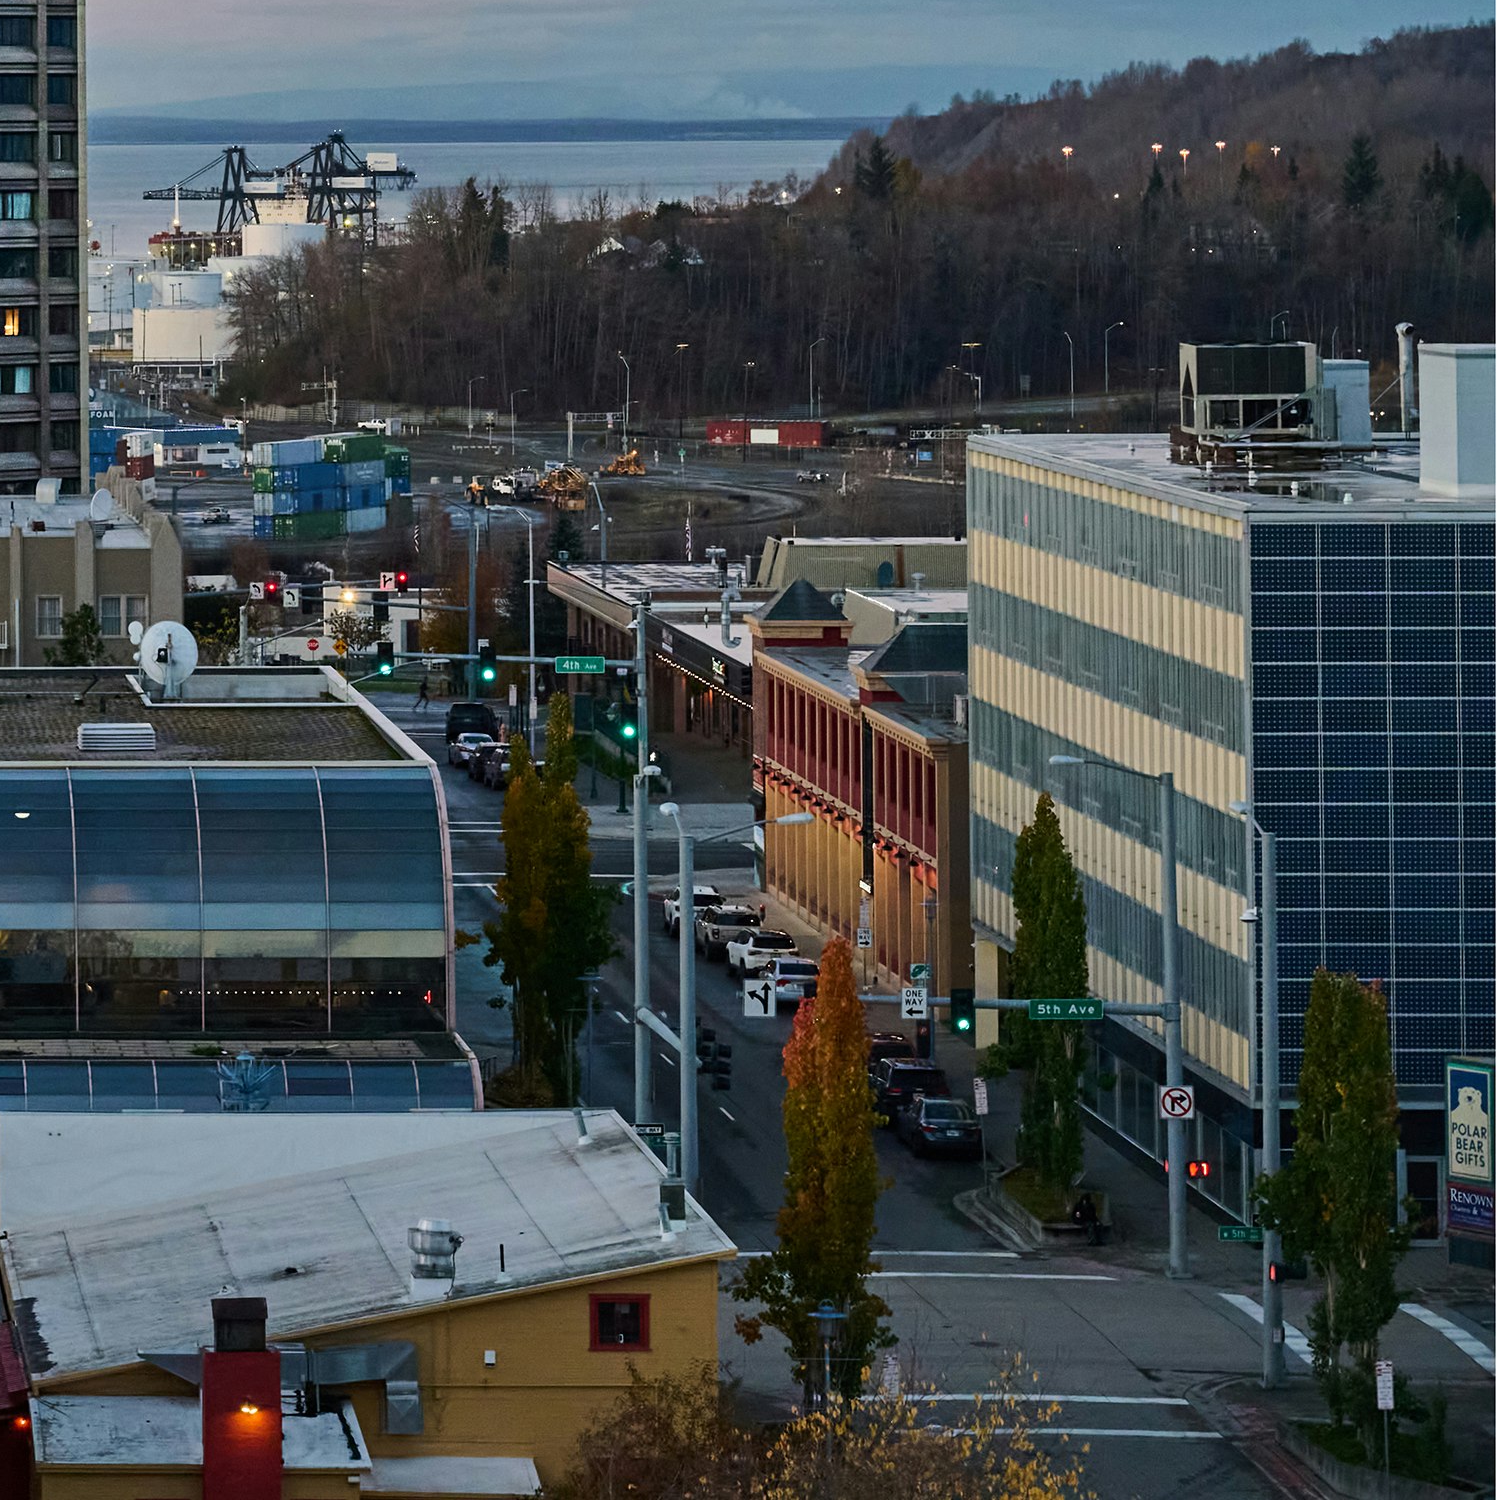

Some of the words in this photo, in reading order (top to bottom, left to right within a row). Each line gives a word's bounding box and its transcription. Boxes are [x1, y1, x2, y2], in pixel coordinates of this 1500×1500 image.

[562, 660, 580, 670] 4th
[905, 989, 923, 998] ONE
[905, 998, 924, 1006] WAY
[1038, 1004, 1061, 1014] 5th
[1068, 1004, 1095, 1014] Ave
[1452, 1122, 1487, 1139] POLAR
[1456, 1137, 1484, 1153] BEAR
[1455, 1152, 1485, 1168] GIFTS
[1450, 1187, 1494, 1209] RENOWN
